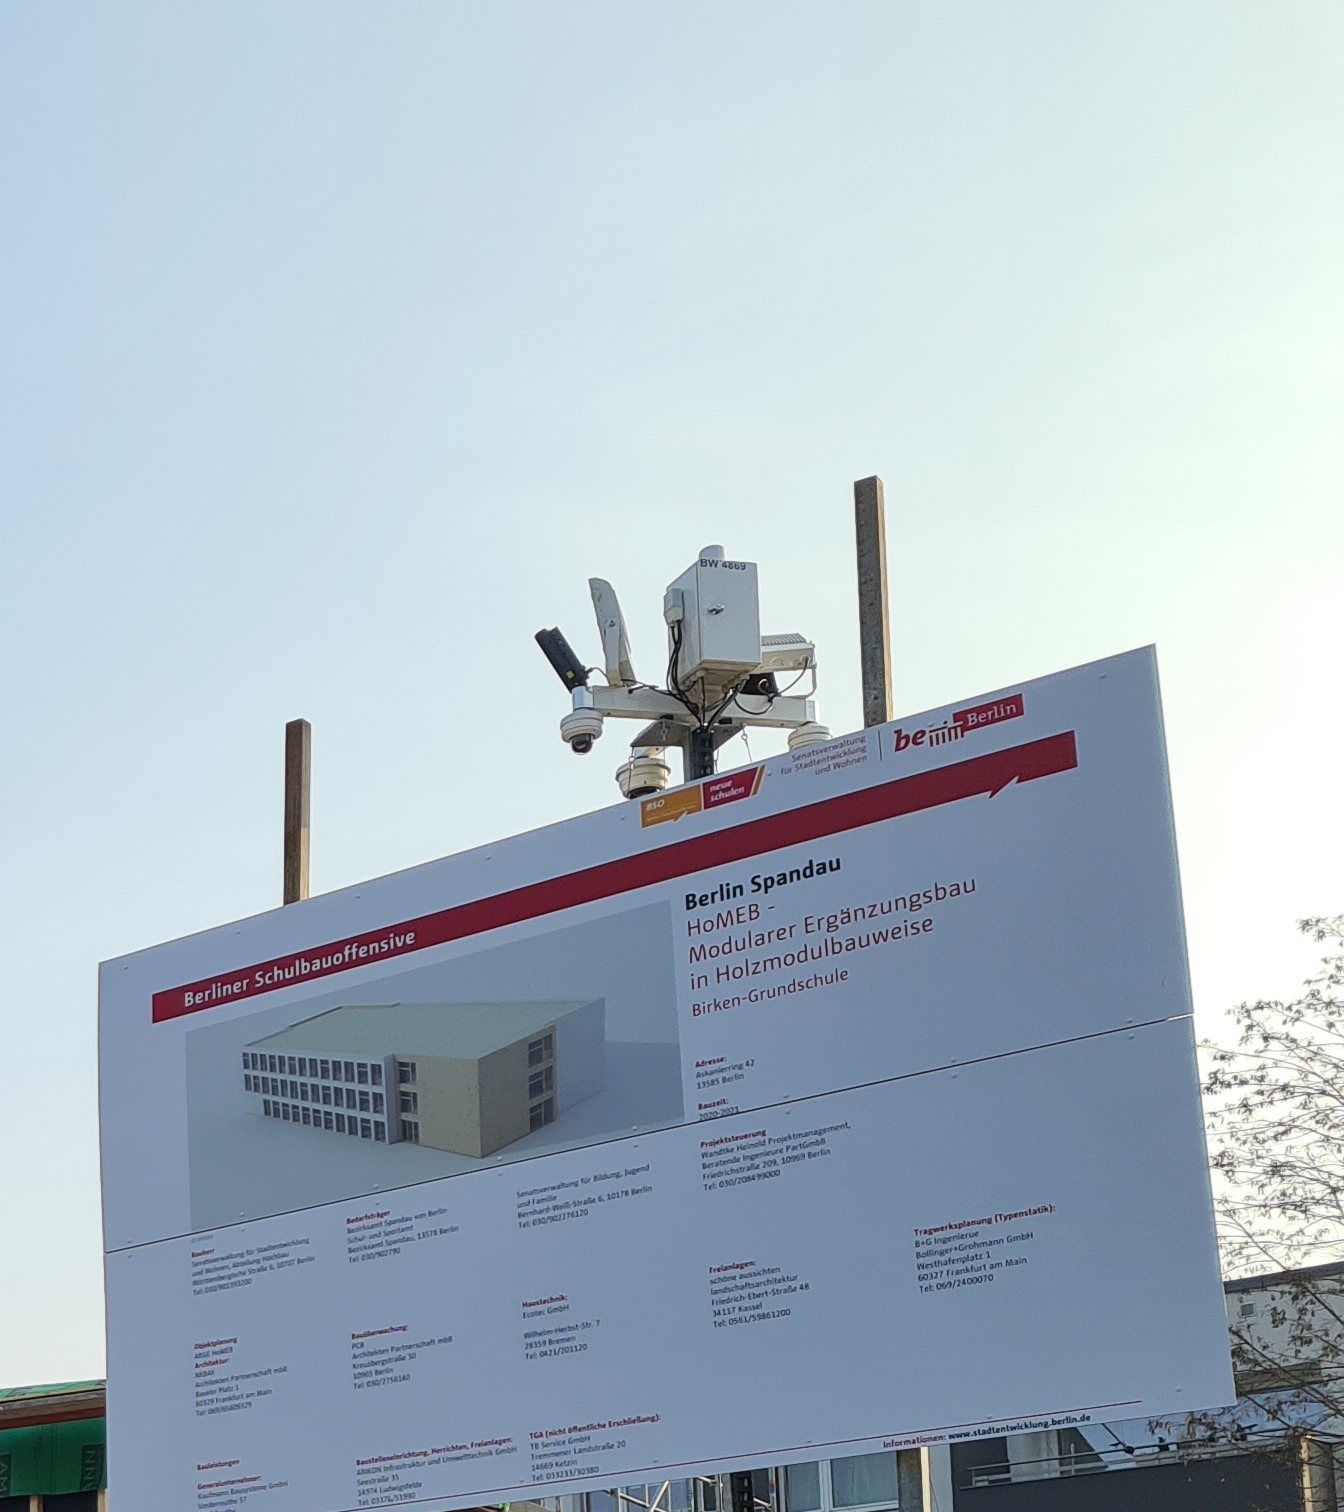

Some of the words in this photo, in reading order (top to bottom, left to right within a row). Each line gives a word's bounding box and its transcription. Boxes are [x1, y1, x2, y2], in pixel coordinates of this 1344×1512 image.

[967, 703, 1017, 727] Berlin
[833, 757, 867, 771] Wohnen
[709, 780, 733, 793] neue
[710, 785, 745, 802] schulen
[685, 882, 744, 911] Berlin
[751, 857, 842, 894] Spandau
[687, 903, 760, 936] HoMEB
[690, 925, 796, 964] Modularer
[804, 880, 976, 935] Ergänzungsbau
[691, 973, 708, 990] in
[716, 918, 934, 984] Holzmodulbauweise
[184, 977, 250, 1007] Berliner
[255, 931, 415, 988] Schulbauoffensive
[692, 969, 849, 1017] Birken-Grundschule
[722, 1073, 744, 1084] Berlin
[808, 1149, 831, 1159] Berlin
[631, 1185, 652, 1195] Berlin
[428, 1208, 447, 1217] Berlin
[914, 1218, 992, 1236] Tragwerksplanung
[915, 1239, 932, 1248] B+G
[1007, 1232, 1033, 1243] GmbH
[947, 1264, 986, 1276] Frankfurt
[1005, 1258, 1027, 1267] Main
[883, 1433, 946, 1448] Informationen:
